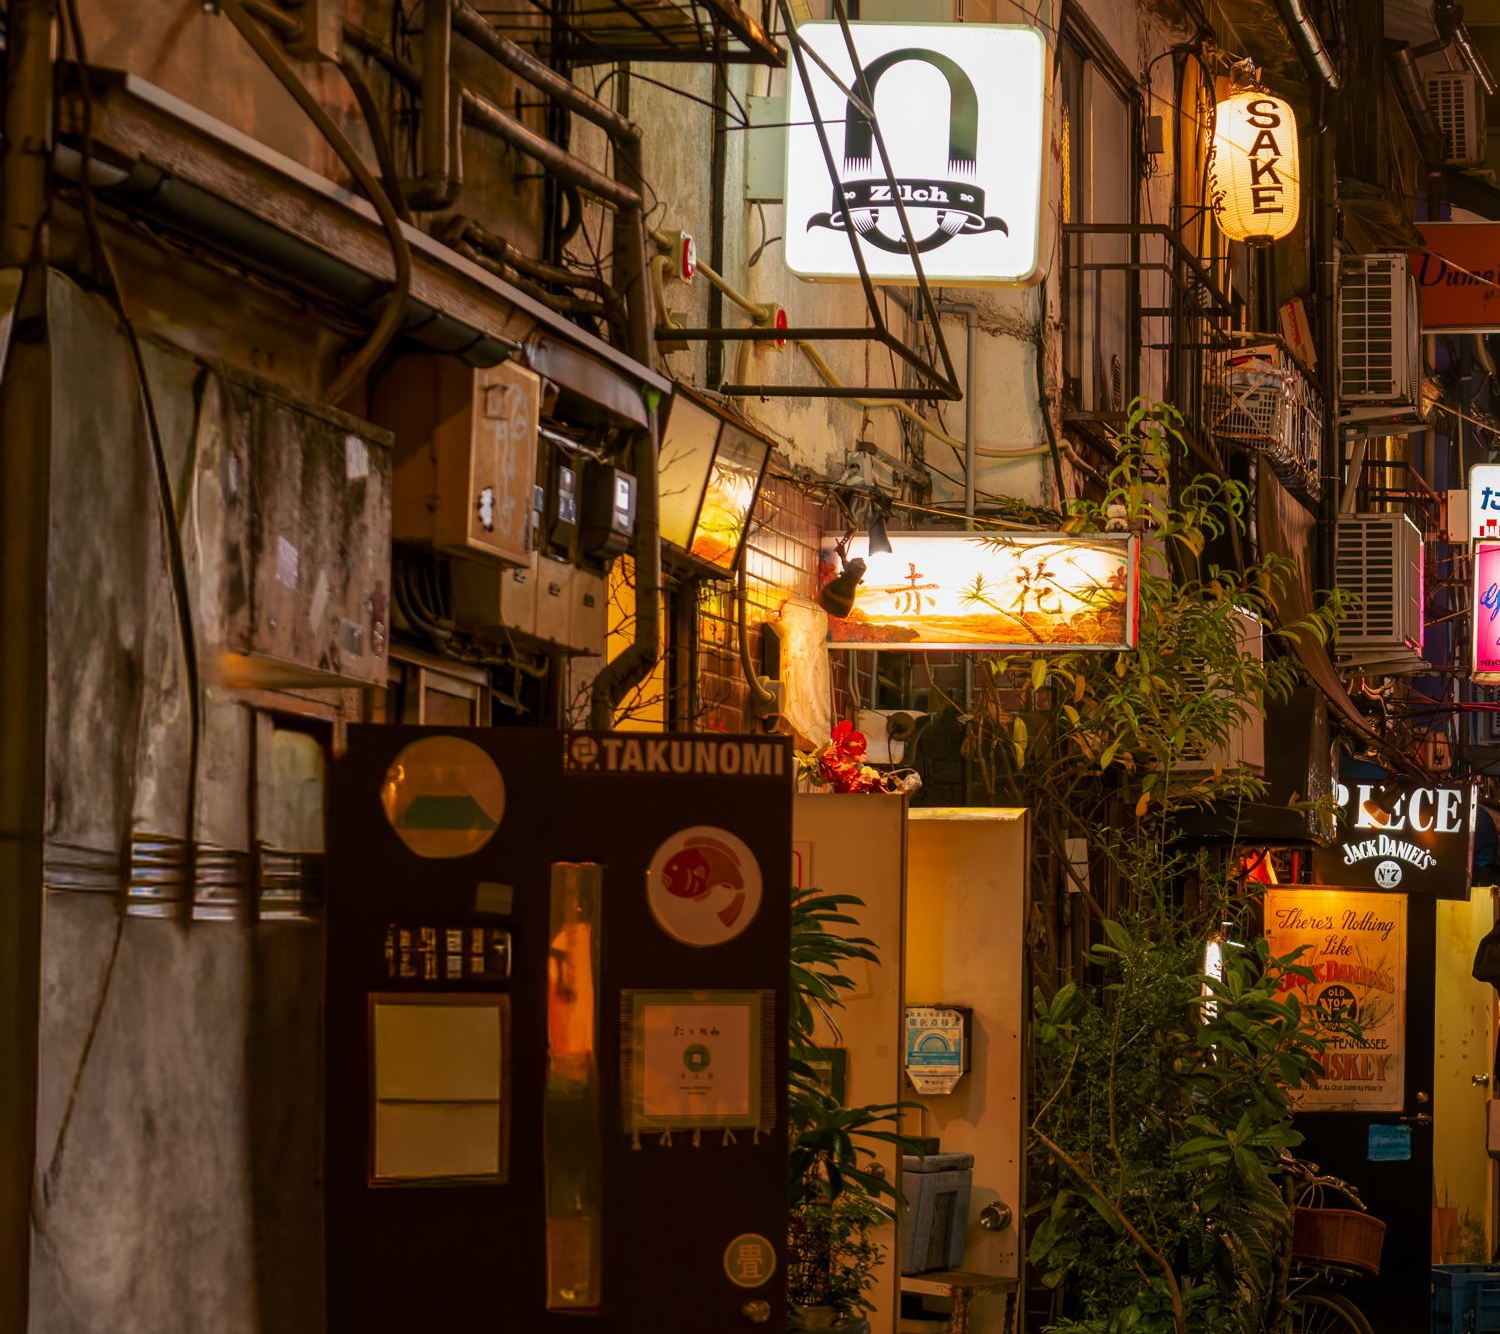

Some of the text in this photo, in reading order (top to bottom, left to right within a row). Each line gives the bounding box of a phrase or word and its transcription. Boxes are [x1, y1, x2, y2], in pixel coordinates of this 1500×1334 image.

[1245, 99, 1284, 215] SAKE
[869, 185, 950, 203] Zilch
[602, 737, 785, 776] TAKUNOMI
[1342, 839, 1379, 866] JACK
[1276, 907, 1395, 942] There's Nothing
[1319, 934, 1353, 956] Like
[1328, 988, 1345, 997] OLD
[737, 1243, 763, 1280] 畳
